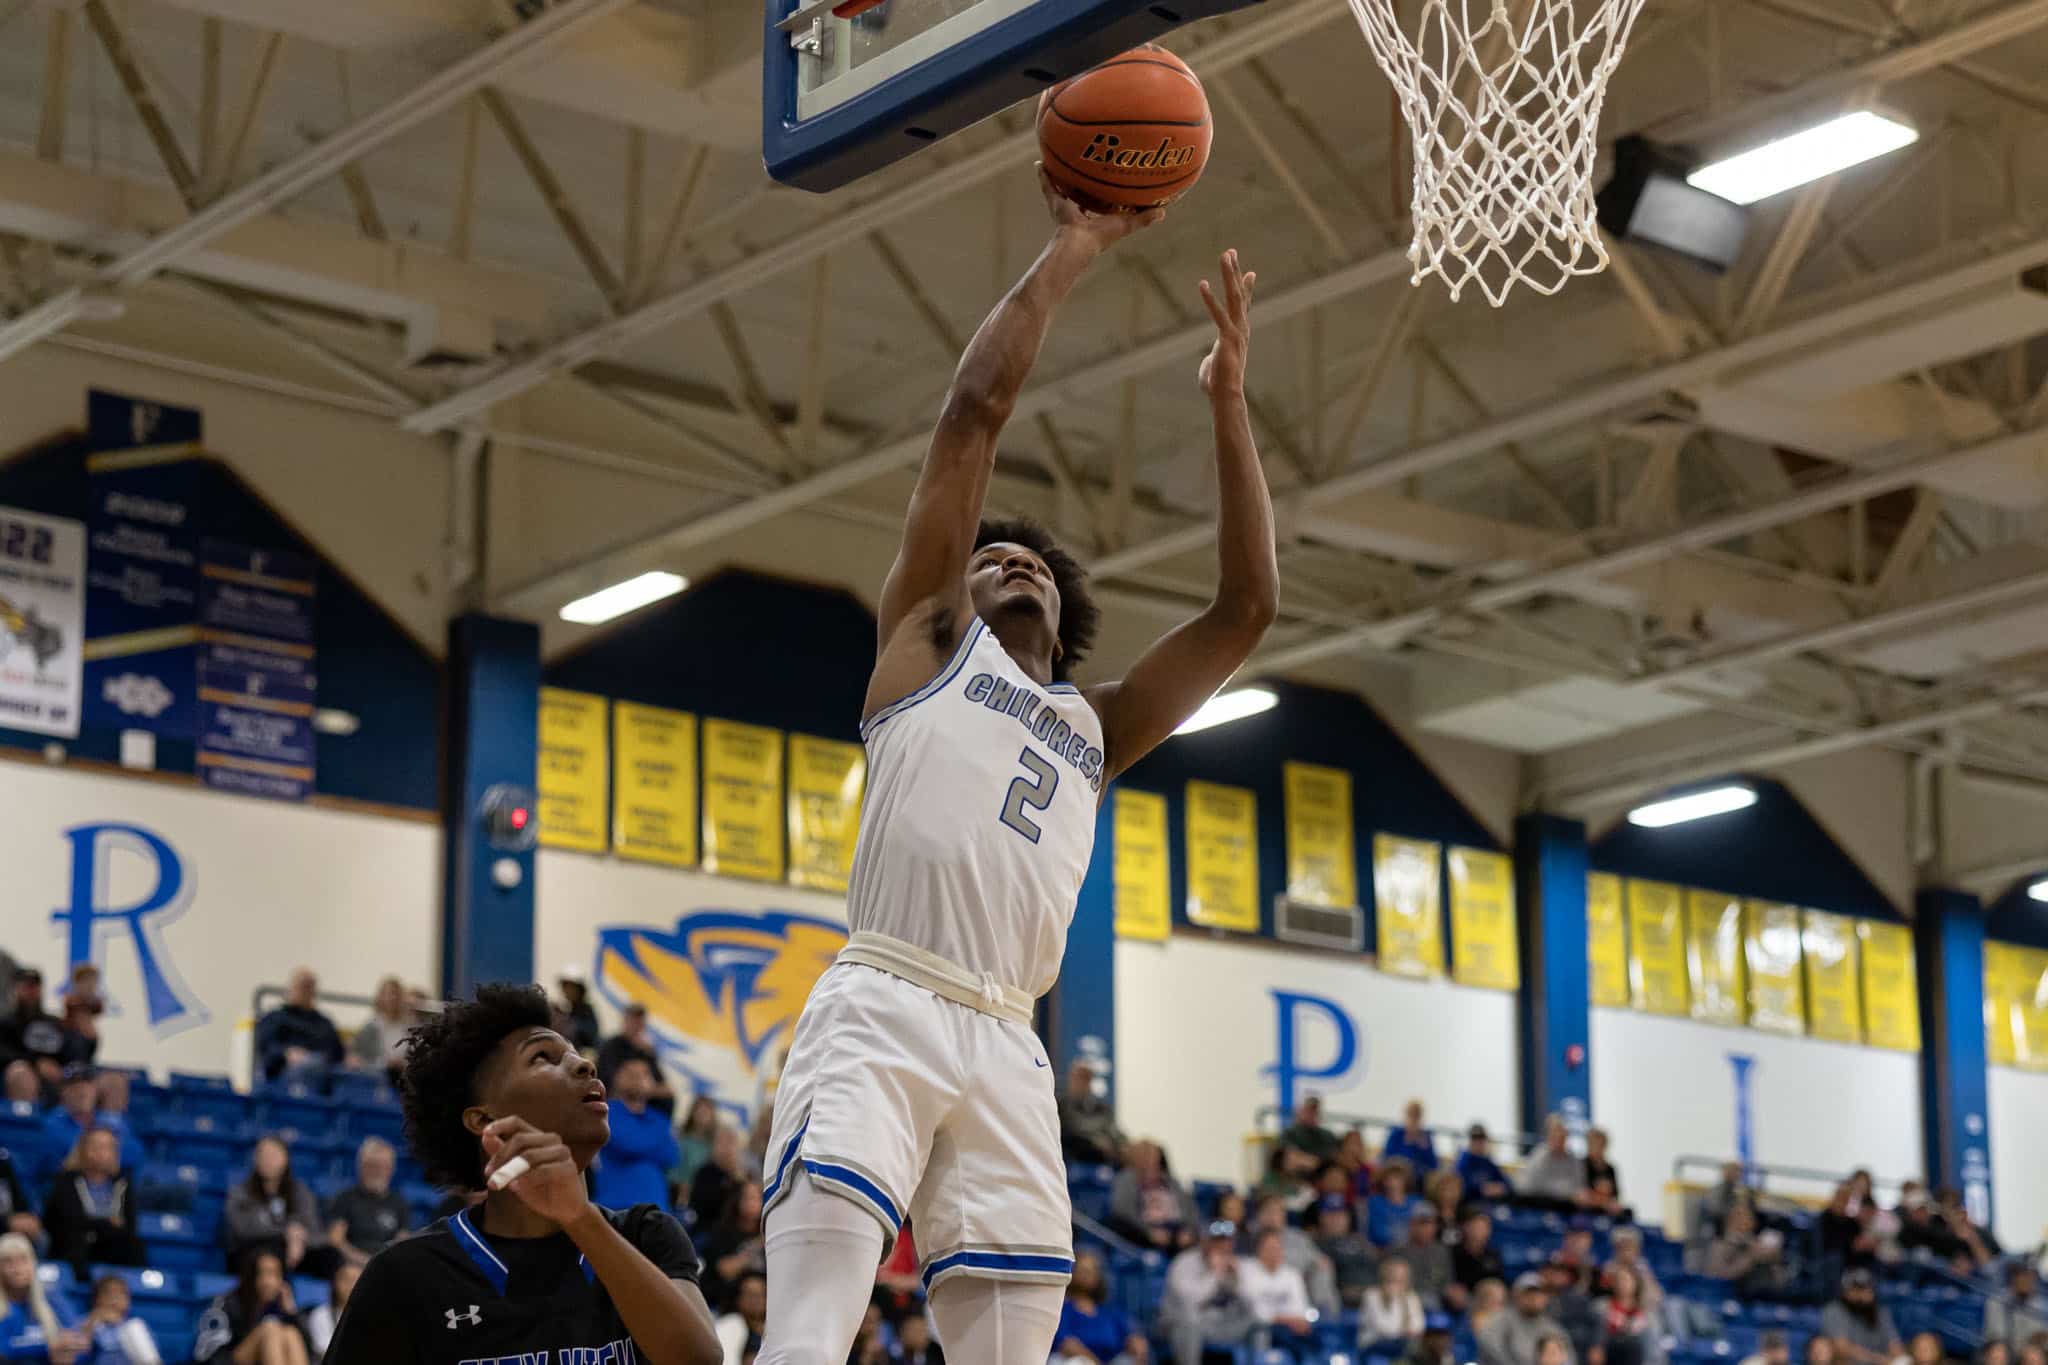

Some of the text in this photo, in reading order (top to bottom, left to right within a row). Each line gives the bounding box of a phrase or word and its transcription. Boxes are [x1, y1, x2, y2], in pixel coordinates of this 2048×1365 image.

[1081, 133, 1196, 168] Baden
[999, 745, 1059, 844] 2
[50, 822, 200, 1032] R
